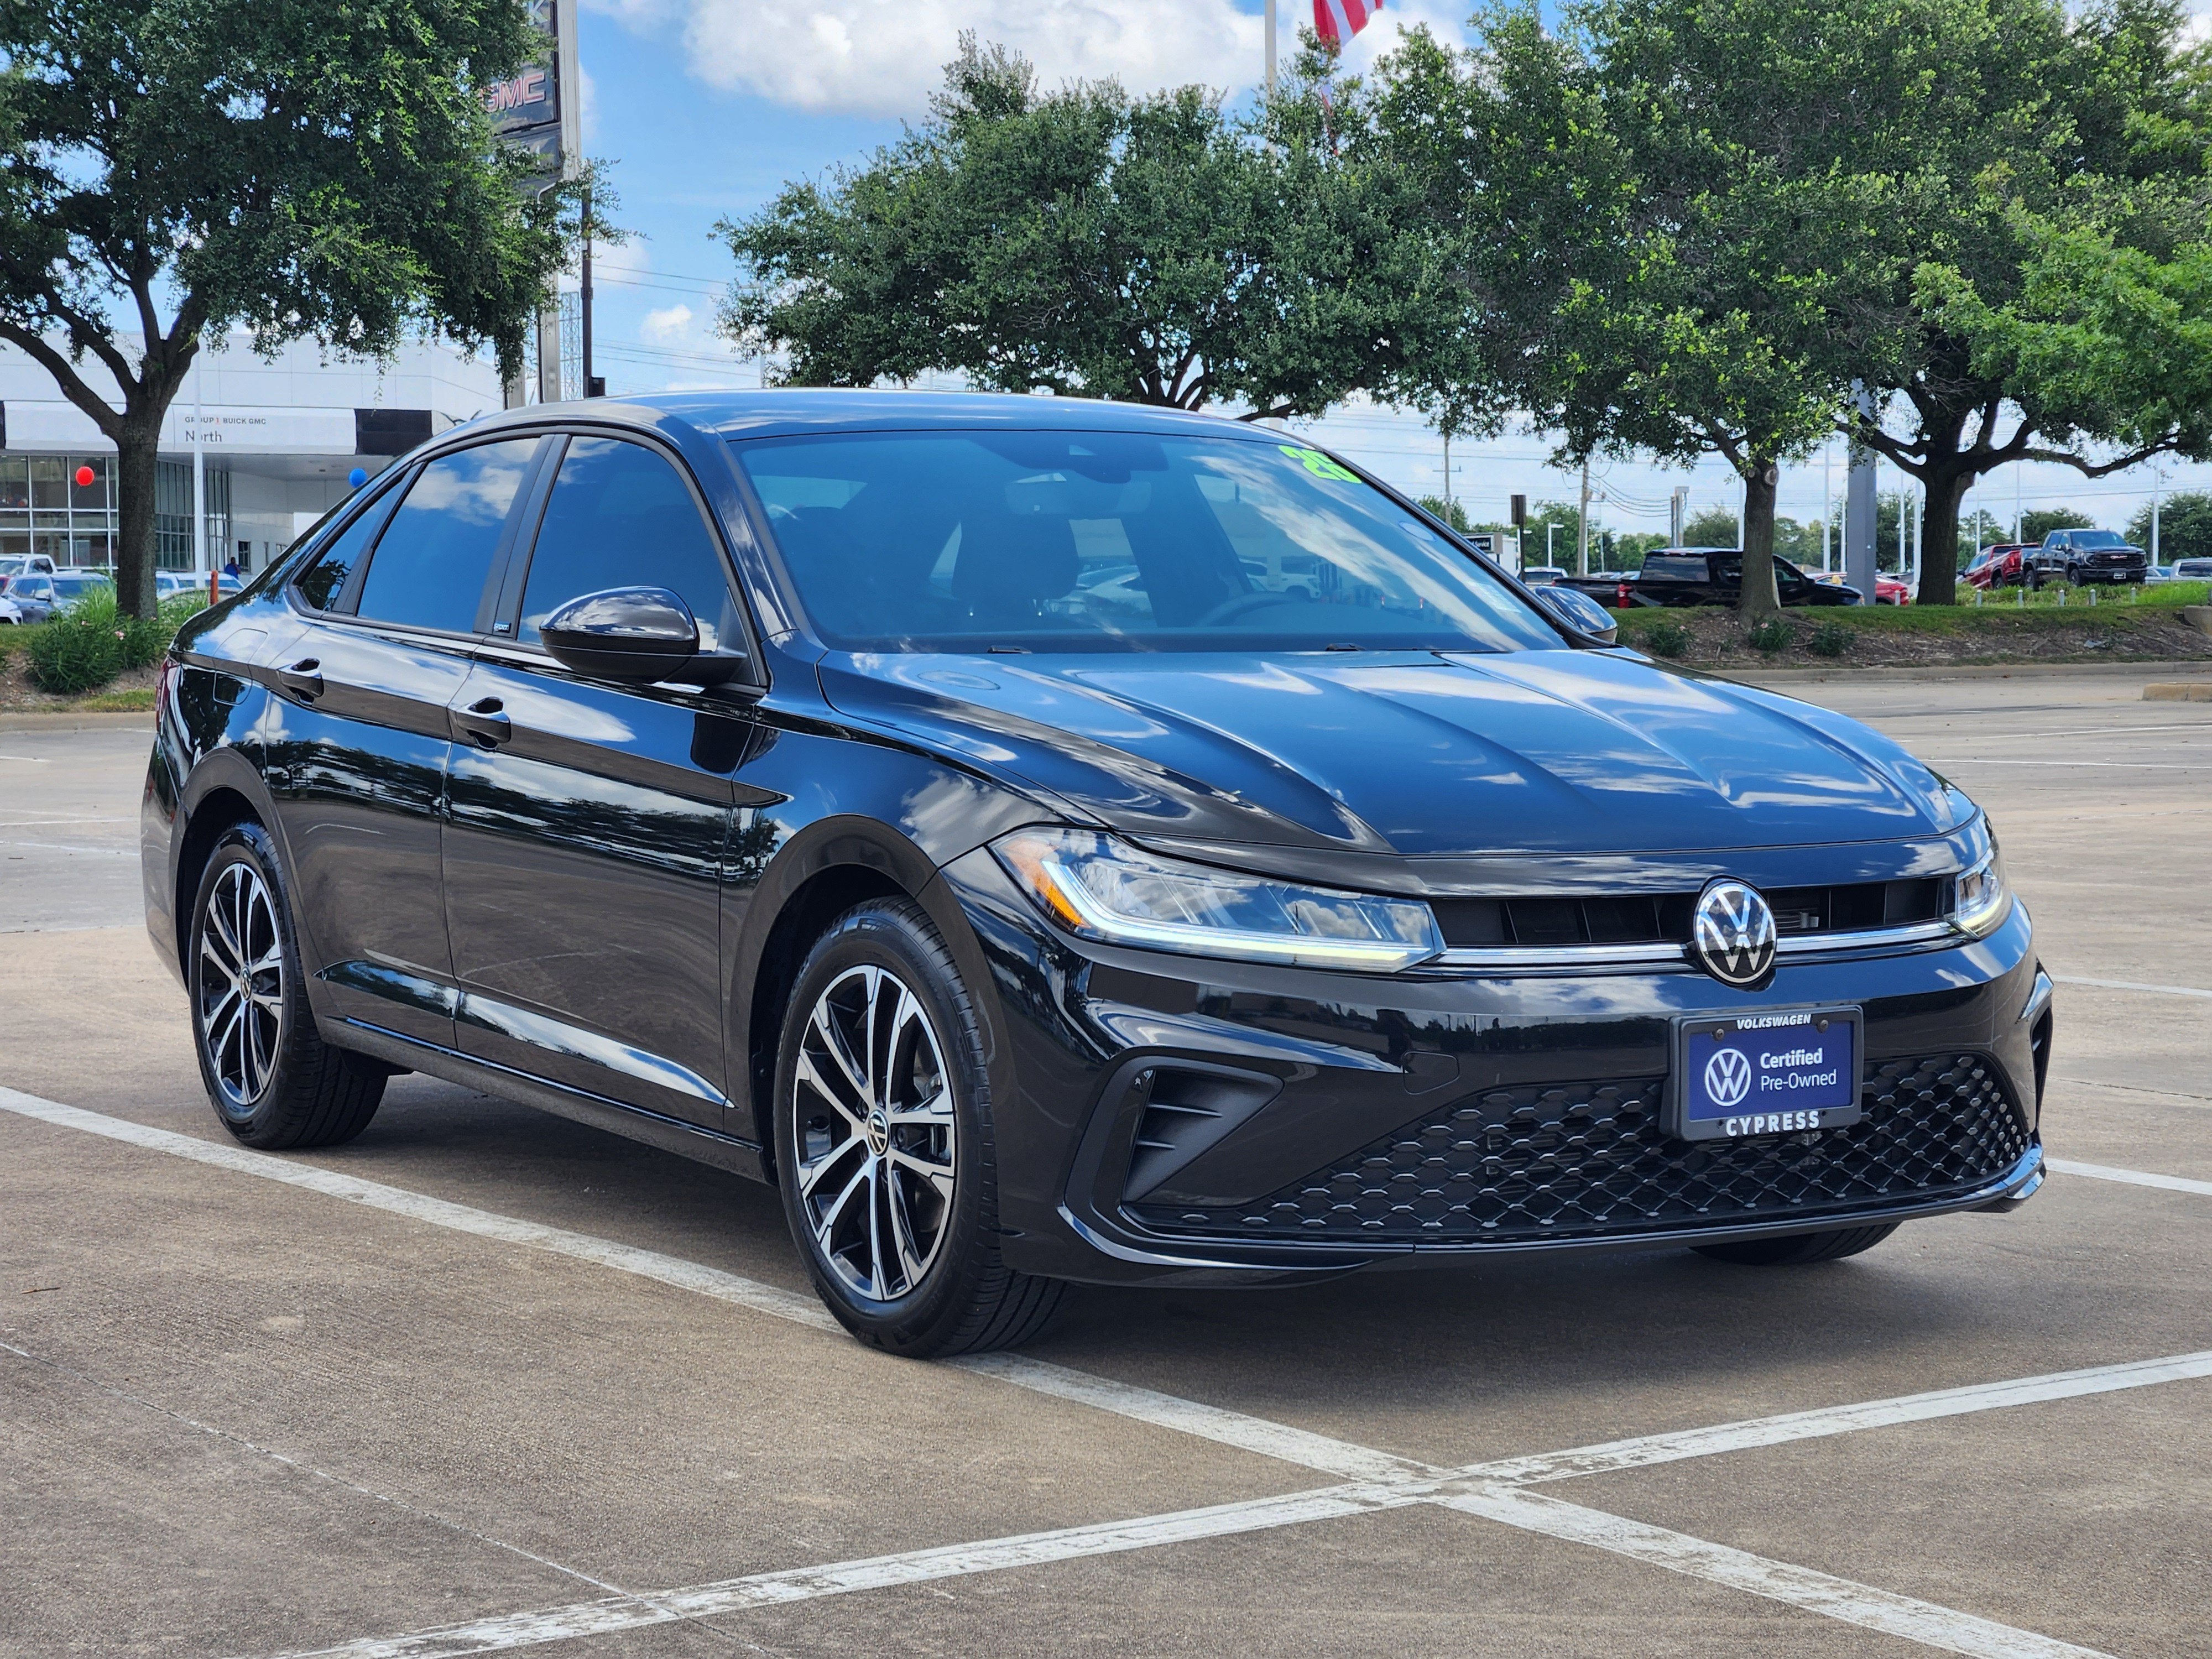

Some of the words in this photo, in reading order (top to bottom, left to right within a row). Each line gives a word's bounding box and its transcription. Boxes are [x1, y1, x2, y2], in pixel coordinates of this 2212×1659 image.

[479, 71, 546, 112] GMC
[185, 430, 222, 442] Nrth
[1736, 1014, 1812, 1030] VOLKSWAGEN
[1760, 1048, 1823, 1070] Certified
[1761, 1069, 1837, 1092] Pre-Owned
[1726, 1110, 1820, 1138] CYPRESS
